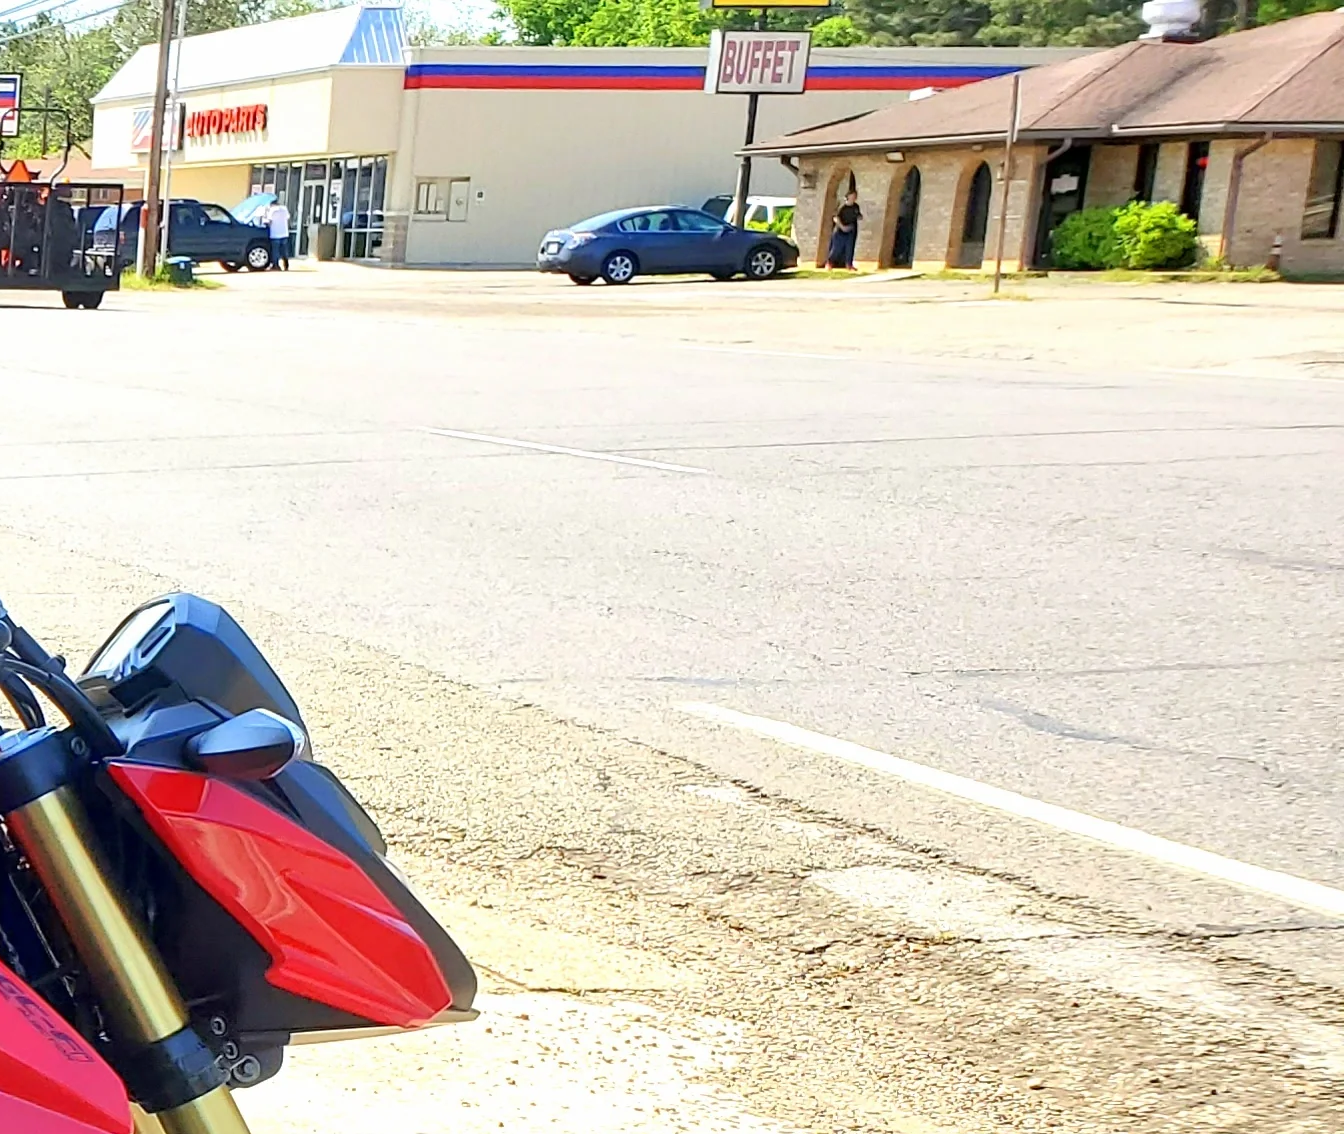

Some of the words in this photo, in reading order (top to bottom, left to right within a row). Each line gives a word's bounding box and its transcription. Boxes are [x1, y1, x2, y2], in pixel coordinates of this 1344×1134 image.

[721, 40, 801, 85] BUFFET
[186, 108, 222, 138] AUTO
[222, 103, 268, 133] PARTS
